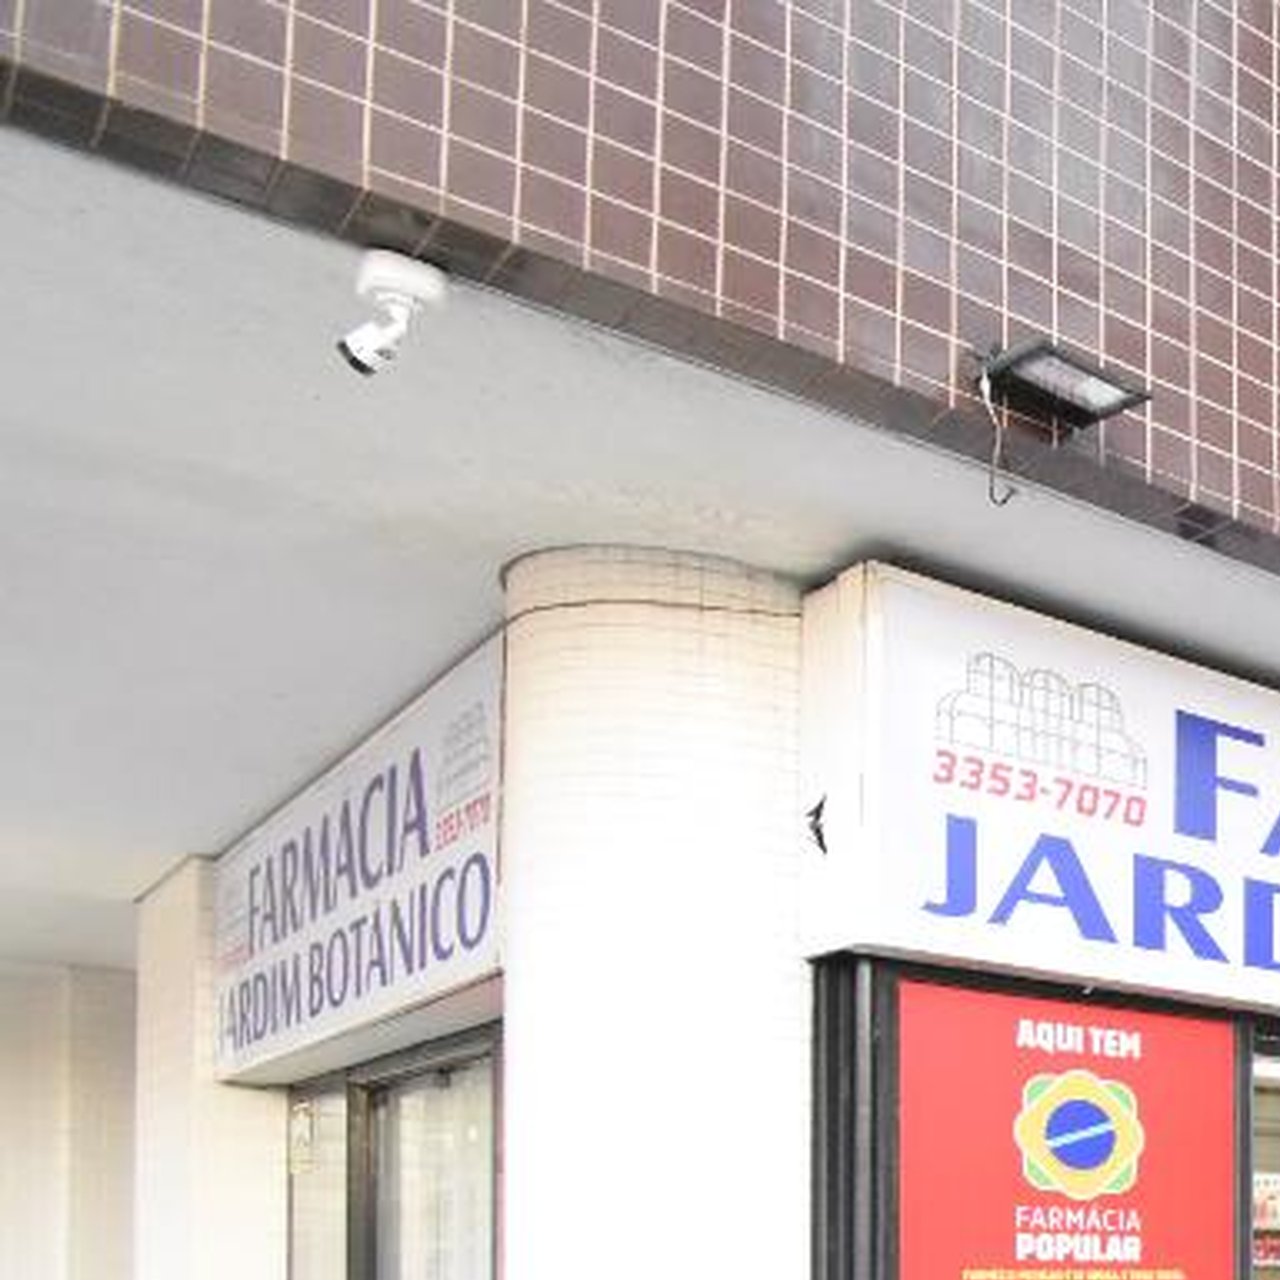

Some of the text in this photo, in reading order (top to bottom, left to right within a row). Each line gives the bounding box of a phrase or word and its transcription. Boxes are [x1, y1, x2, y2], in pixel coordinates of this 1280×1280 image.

[932, 748, 1148, 827] 3353-7070
[1016, 1019, 1142, 1060] AQUI TEM
[1014, 1203, 1142, 1232] FARMÁCIA
[1014, 1232, 1142, 1263] POPULAR
